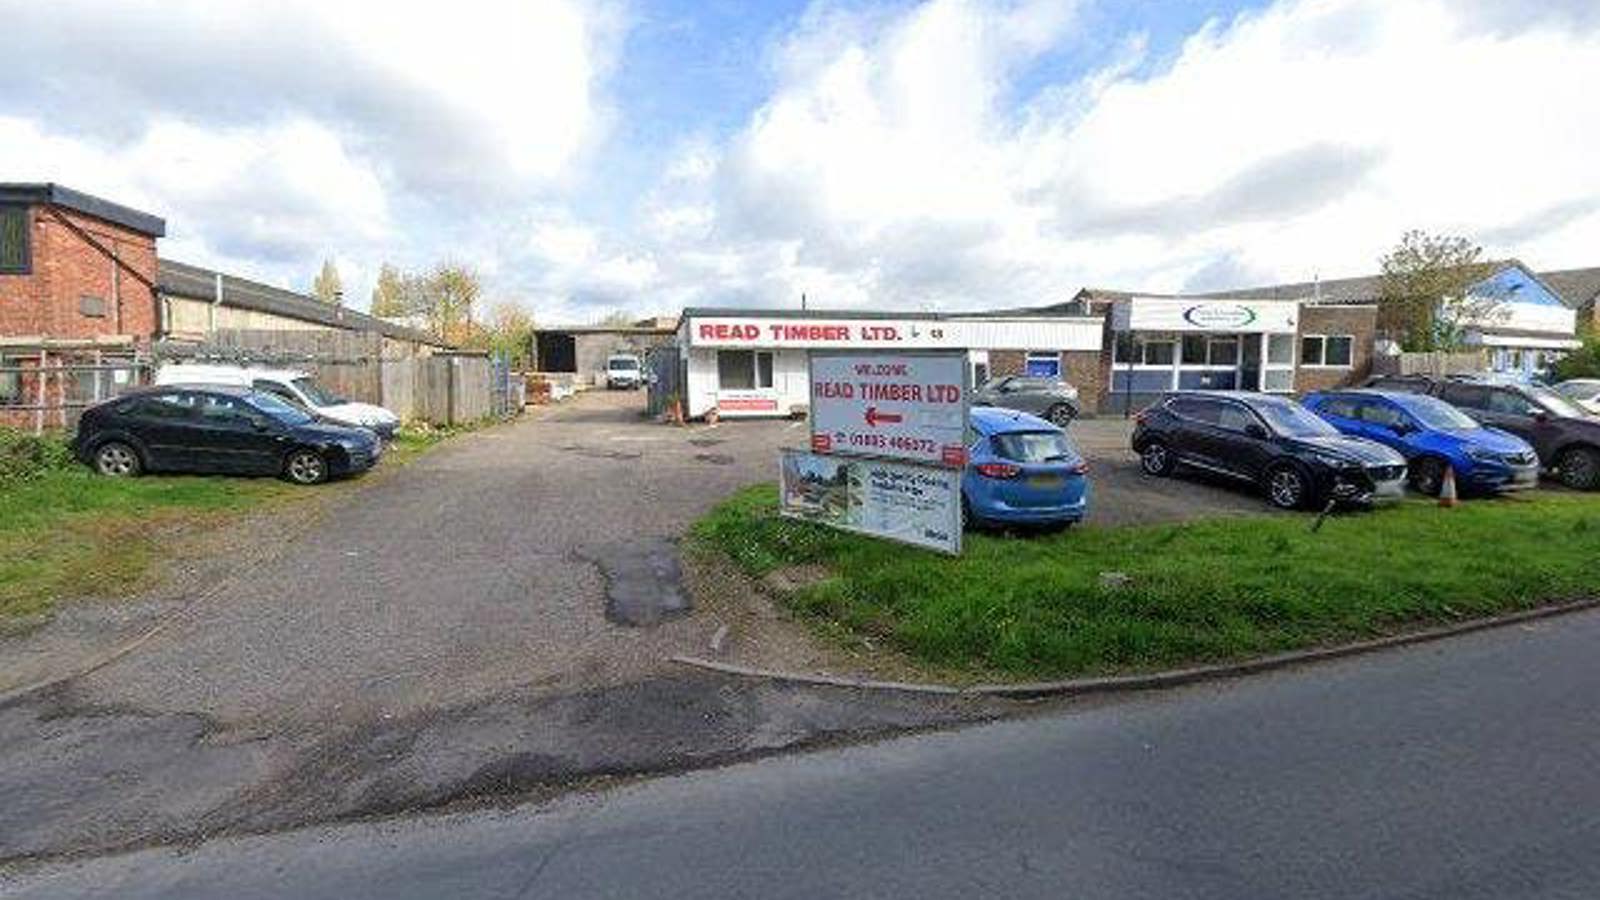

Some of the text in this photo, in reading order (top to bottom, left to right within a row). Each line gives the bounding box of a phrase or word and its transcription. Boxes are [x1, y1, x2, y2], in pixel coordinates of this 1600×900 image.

[699, 324, 903, 341] READ TIMBER LTD.
[814, 381, 961, 404] READ TIMBER LTD
